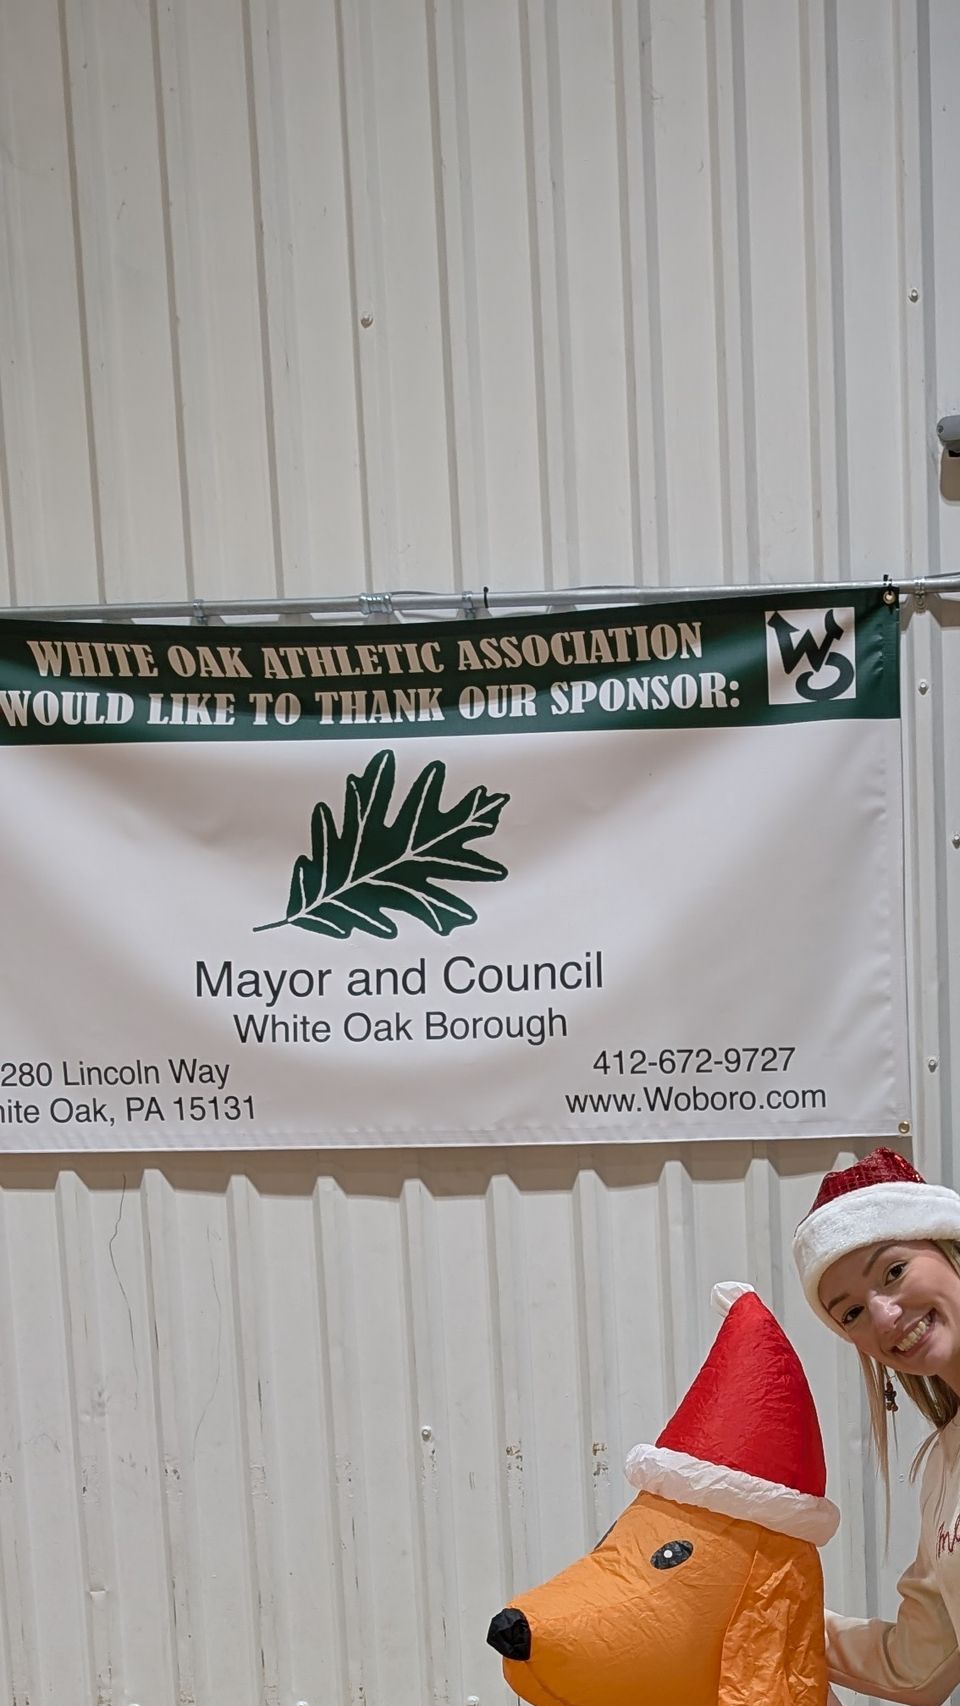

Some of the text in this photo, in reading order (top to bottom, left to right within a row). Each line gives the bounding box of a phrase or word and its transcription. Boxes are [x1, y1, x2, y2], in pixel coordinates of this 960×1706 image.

[26, 621, 703, 680] WHITE OAK ATHLETIC ASSOCIATION
[0, 672, 741, 726] WOULD LIKE TO THANK OUR SPONSOR:
[196, 950, 604, 1008] Mayor and Council
[233, 1007, 568, 1046] White Oak Borough
[62, 1059, 160, 1087] Lincoln
[168, 1058, 230, 1090] Way
[592, 1047, 796, 1076] 412-672-9727
[49, 1098, 115, 1127] Oak,
[126, 1096, 165, 1122] PA
[173, 1095, 256, 1121] 15131
[565, 1085, 827, 1114] www.Woboro.com
